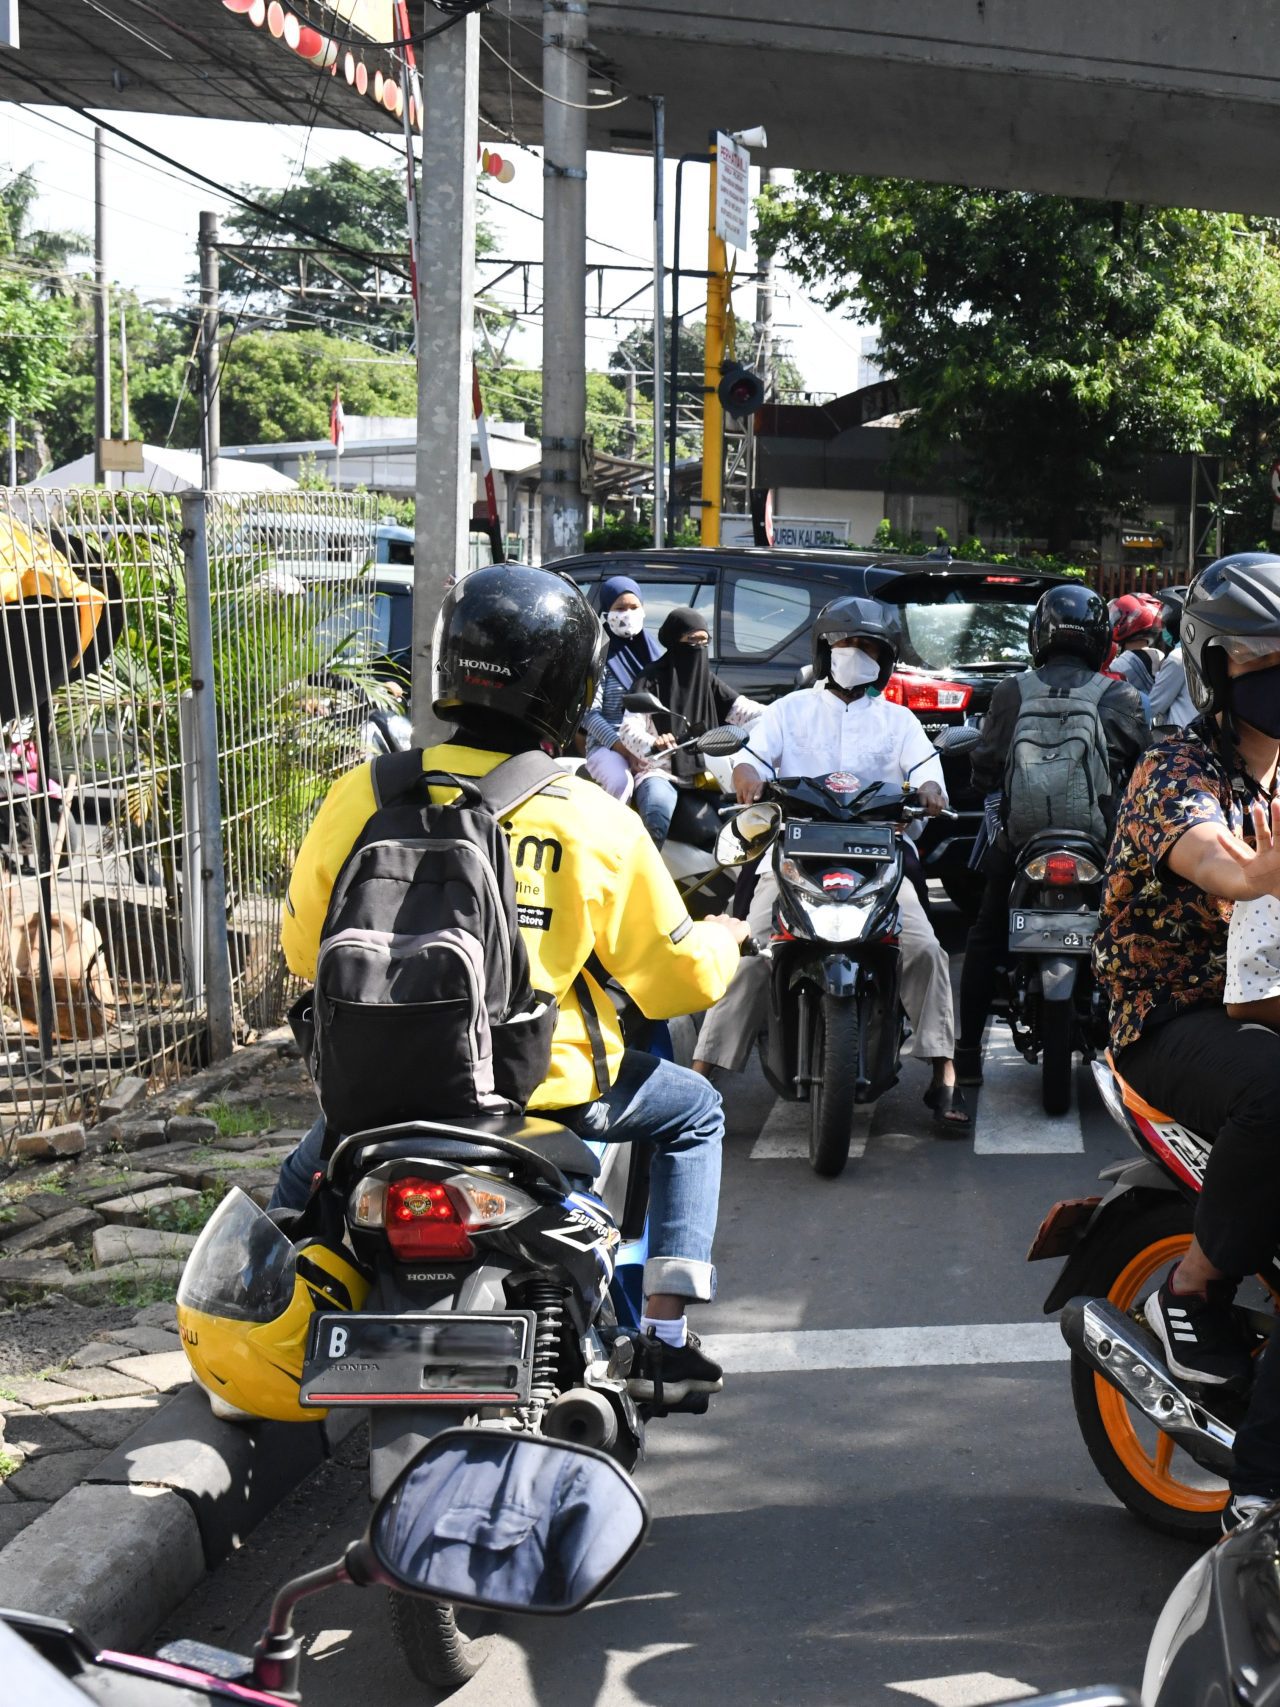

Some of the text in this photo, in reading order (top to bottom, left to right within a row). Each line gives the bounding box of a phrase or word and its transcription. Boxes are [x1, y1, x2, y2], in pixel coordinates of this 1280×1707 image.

[1058, 623, 1085, 632] HONDA
[458, 658, 512, 676] HONDA
[792, 827, 802, 840] B
[519, 914, 544, 927] Store
[1016, 915, 1025, 930] B
[406, 1273, 456, 1281] HONDA
[328, 1326, 348, 1358] B
